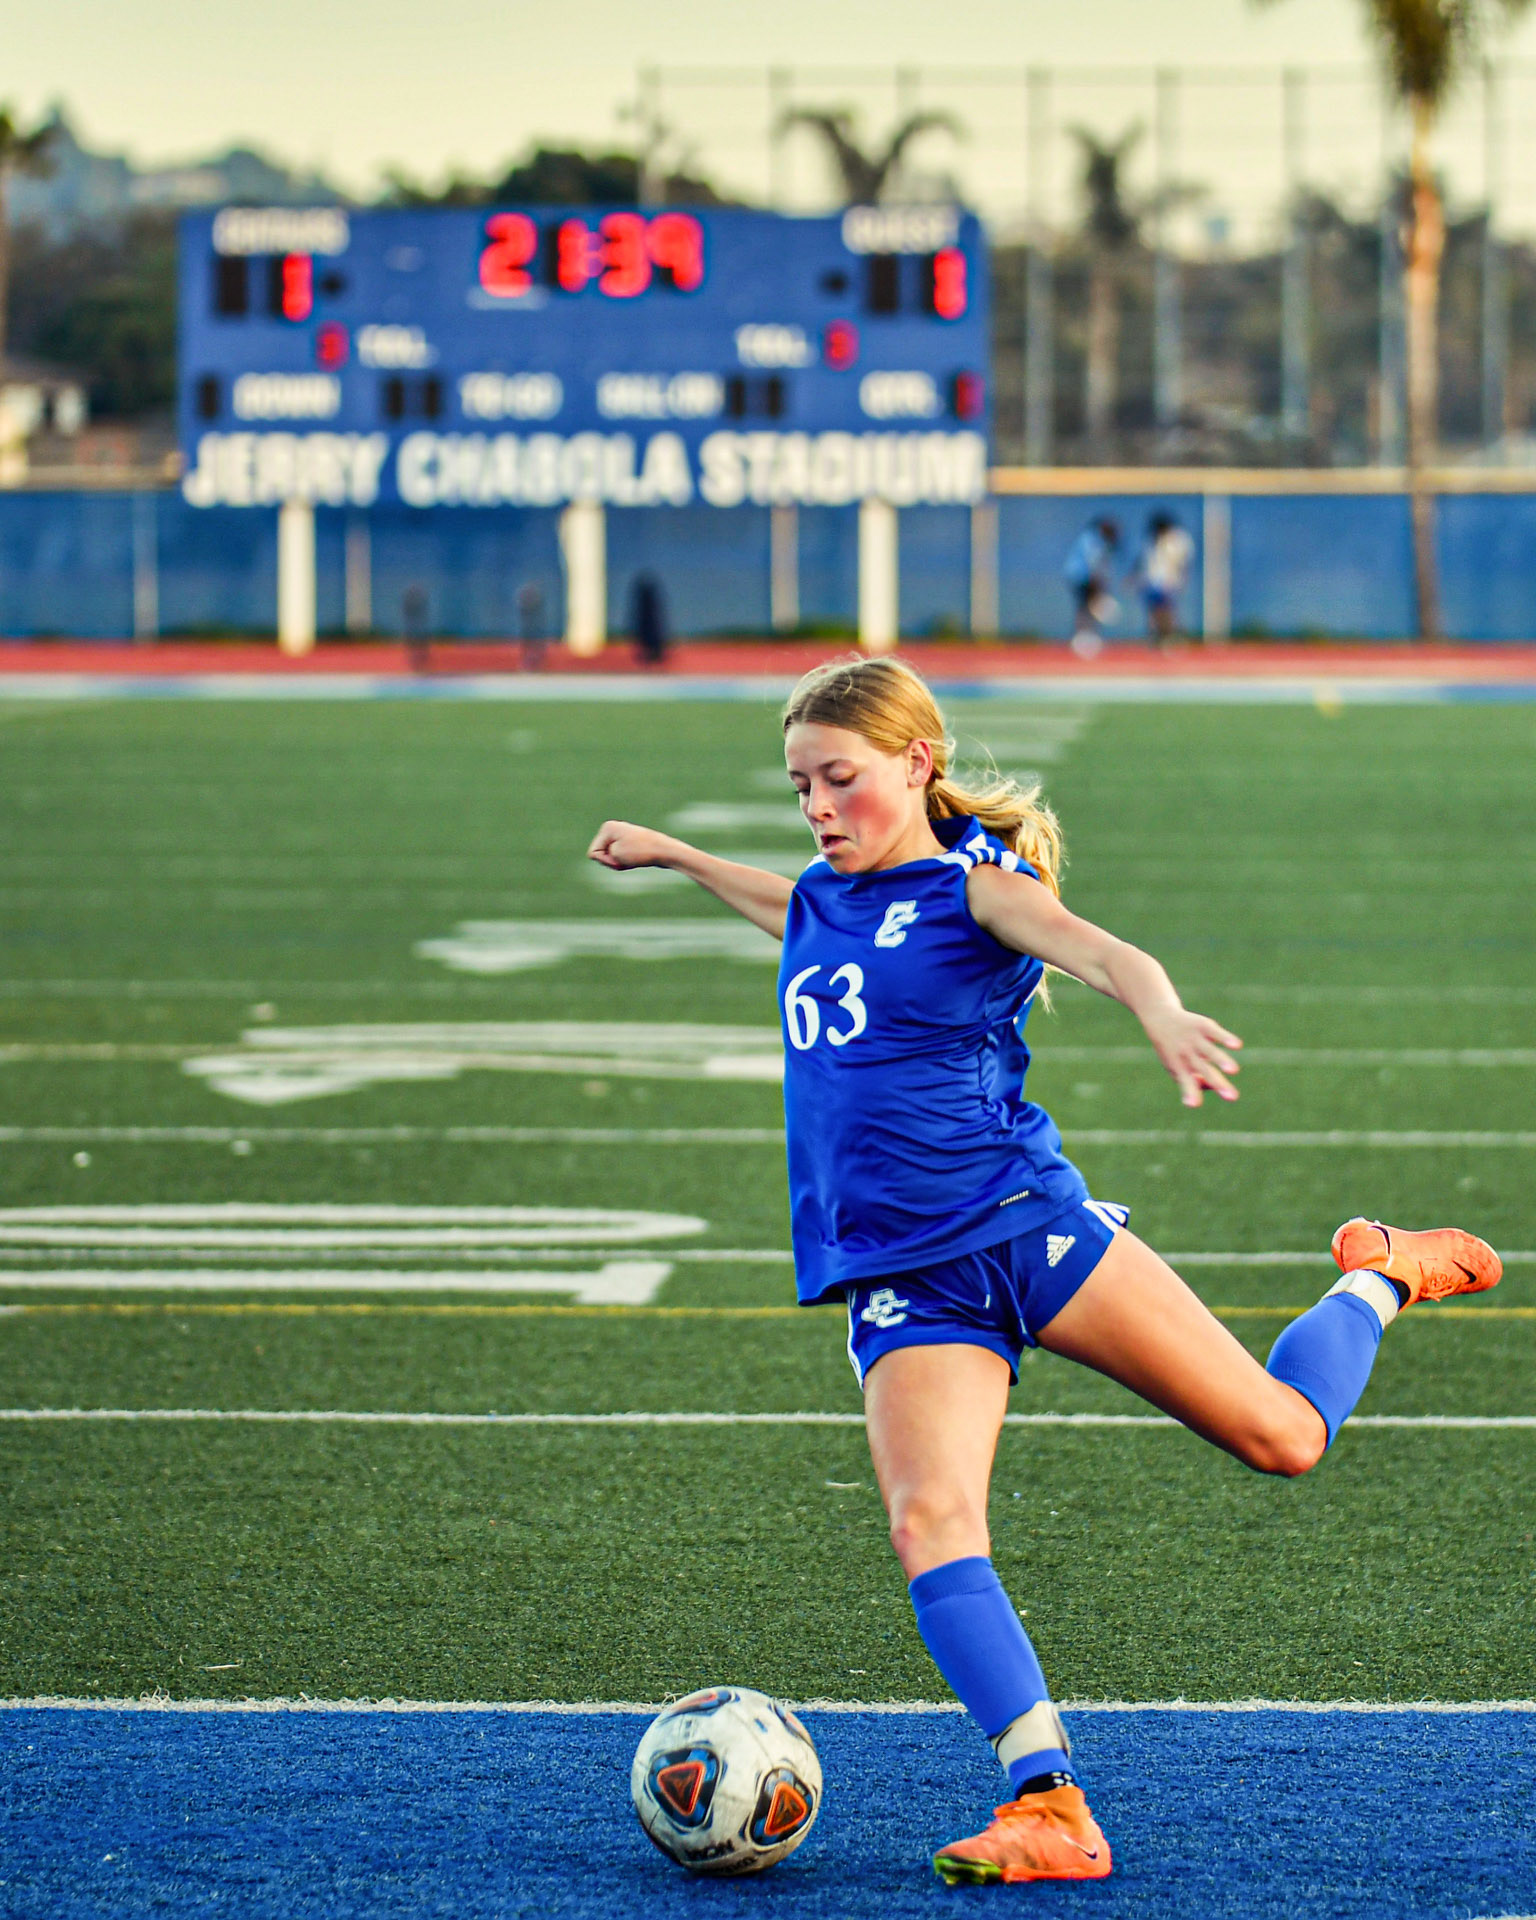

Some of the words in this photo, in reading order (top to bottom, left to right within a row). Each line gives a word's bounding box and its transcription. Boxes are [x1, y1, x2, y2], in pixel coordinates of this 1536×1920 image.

[481, 213, 705, 298] 21:39
[183, 431, 389, 508] JERRY
[699, 430, 987, 508] STADIUM
[784, 962, 867, 1051] 63
